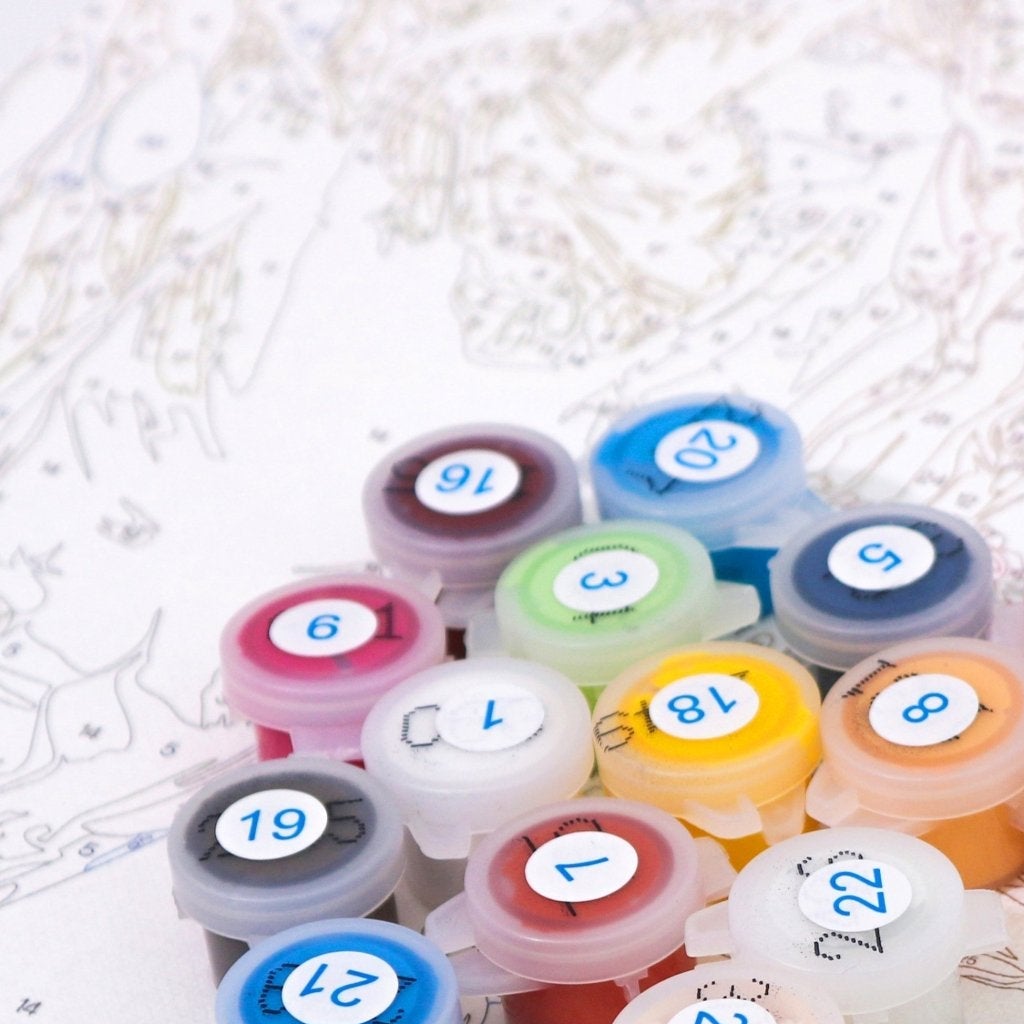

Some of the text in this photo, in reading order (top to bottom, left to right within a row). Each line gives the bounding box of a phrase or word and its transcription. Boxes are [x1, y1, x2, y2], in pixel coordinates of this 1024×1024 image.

[675, 429, 736, 468] 20
[438, 466, 492, 494] 16
[859, 544, 901, 571] 5
[581, 572, 628, 589] 3
[308, 615, 340, 639] 6
[484, 701, 502, 729] 1
[668, 687, 736, 723] 18
[903, 693, 948, 723] 8
[242, 809, 306, 840] 19
[556, 858, 608, 881] 7
[830, 869, 886, 916] 22
[300, 964, 378, 1007] 21
[17, 998, 41, 1015] 14
